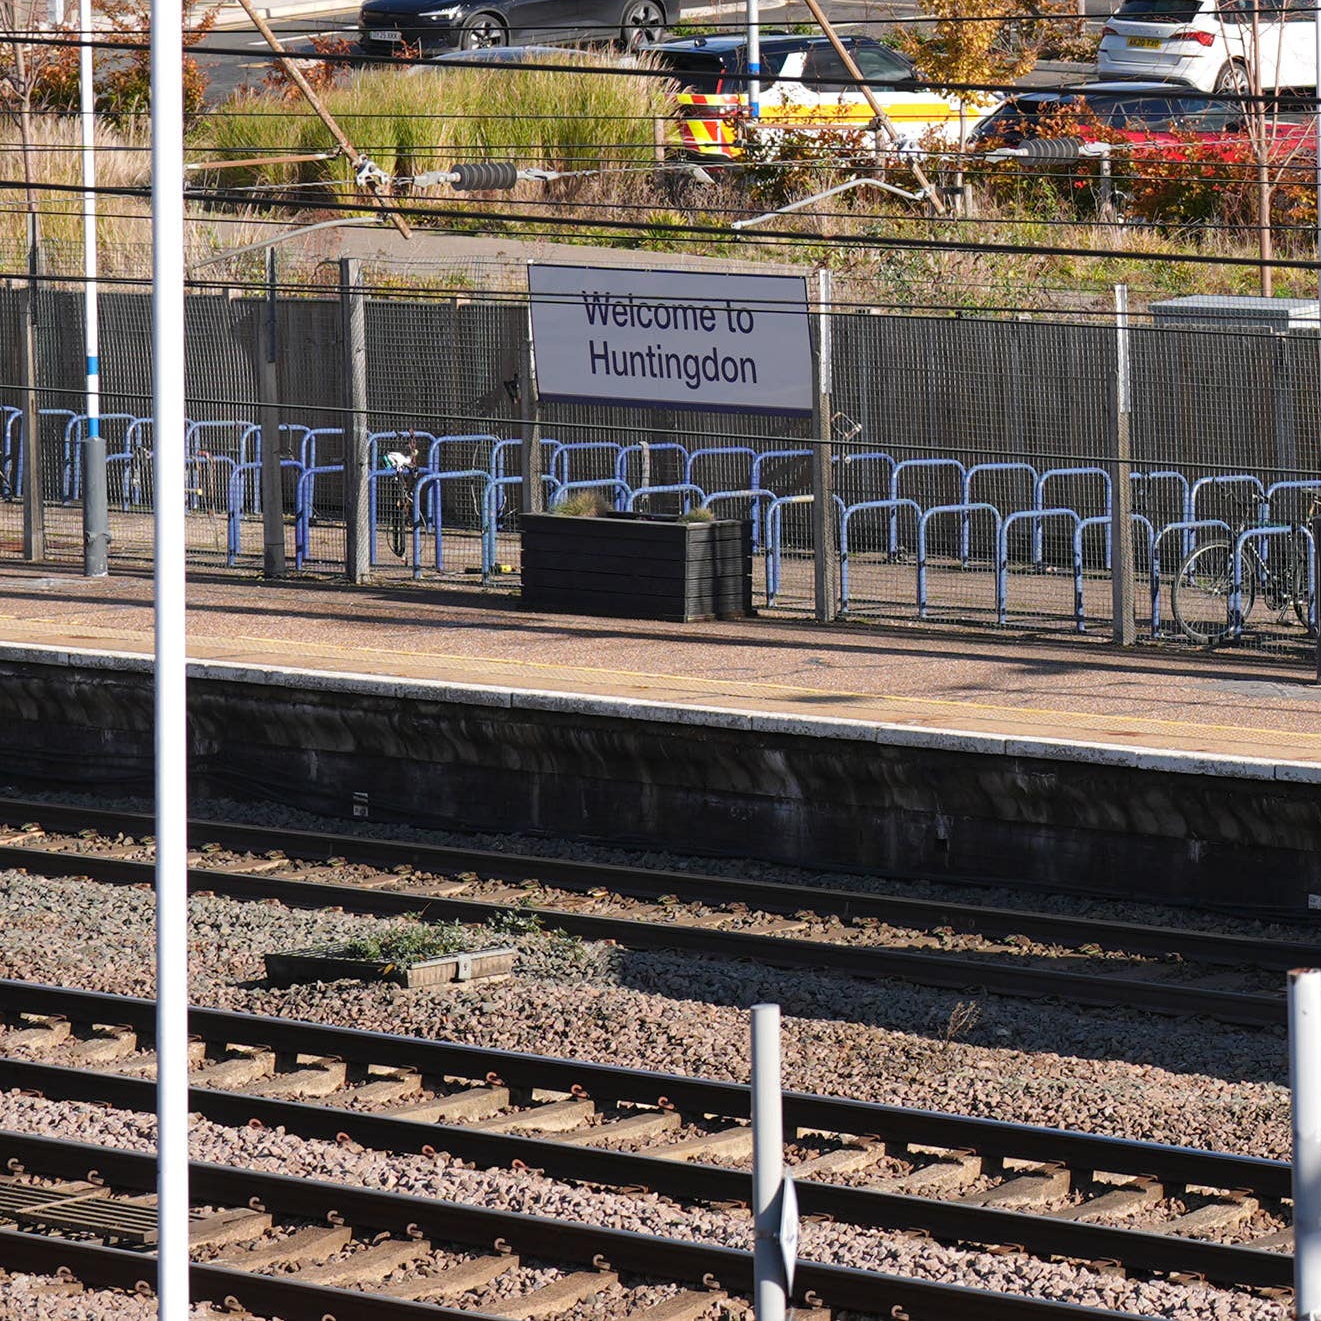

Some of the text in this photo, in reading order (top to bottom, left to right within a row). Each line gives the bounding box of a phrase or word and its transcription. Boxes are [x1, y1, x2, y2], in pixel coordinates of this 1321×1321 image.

[582, 291, 754, 334] Welcome to
[589, 340, 757, 390] Huntingdon
